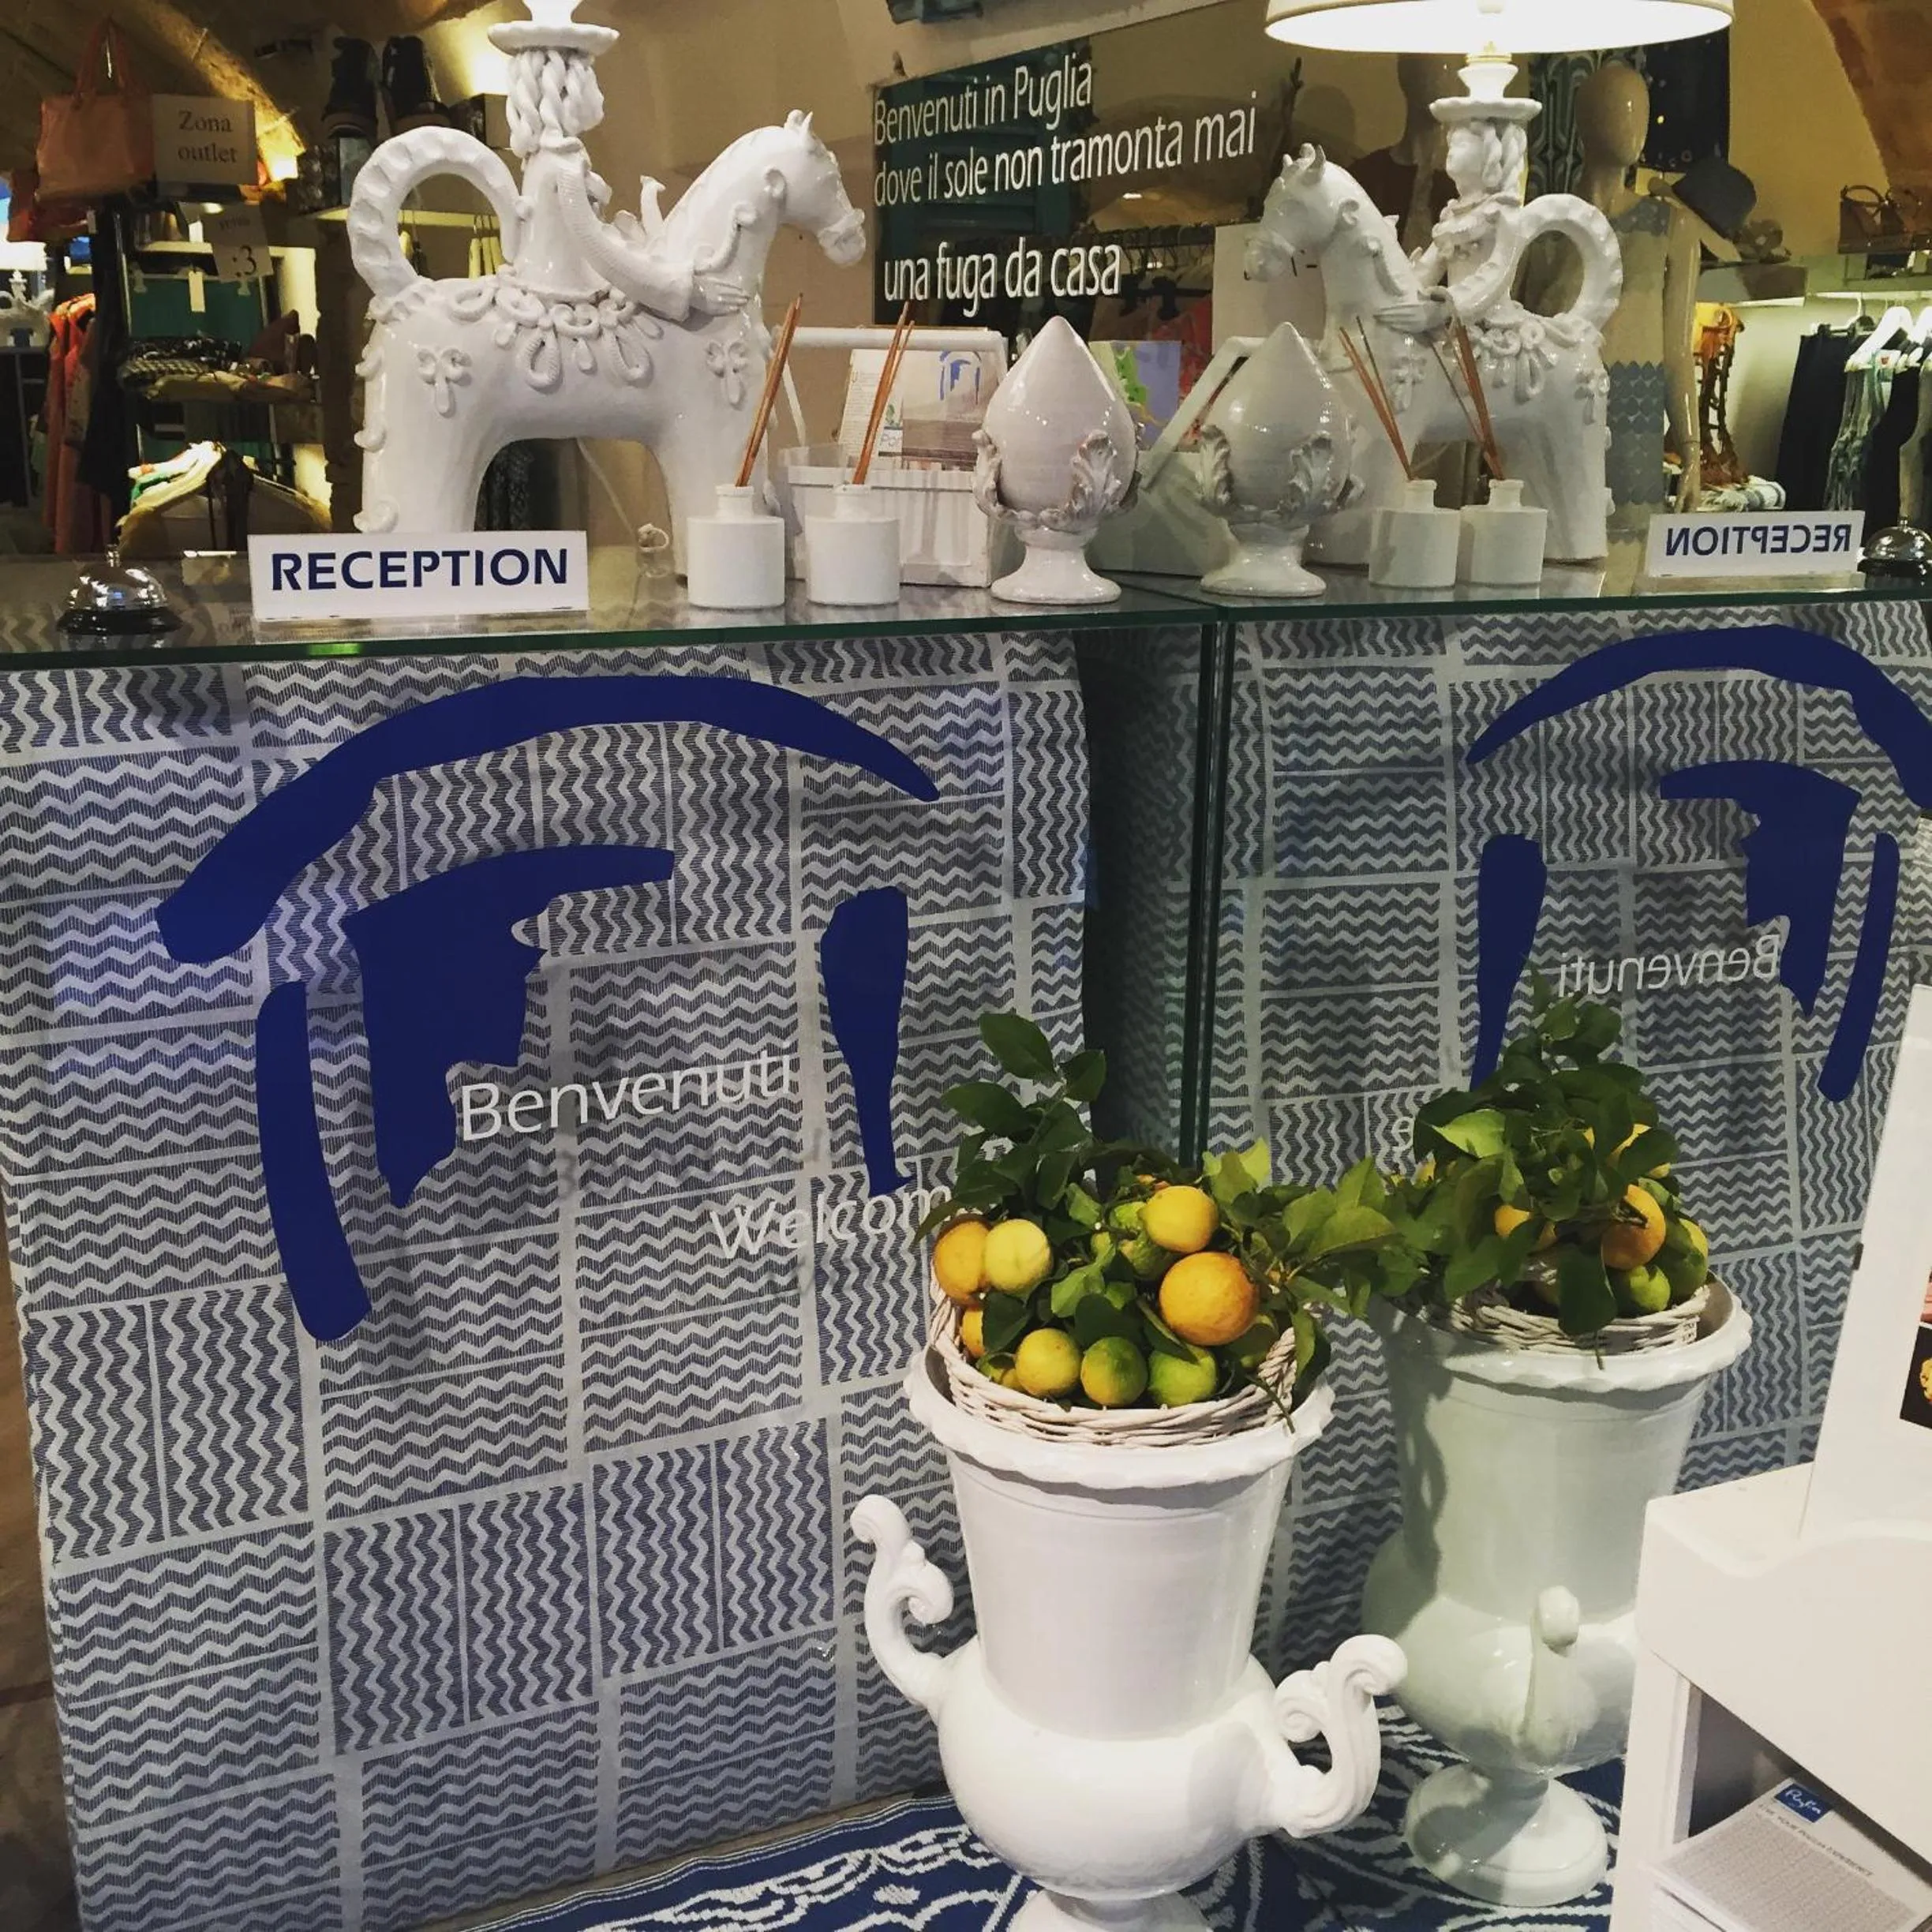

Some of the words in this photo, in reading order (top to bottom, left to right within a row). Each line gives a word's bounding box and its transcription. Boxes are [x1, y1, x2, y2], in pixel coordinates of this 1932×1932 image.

[178, 110, 234, 133] Zona
[874, 77, 978, 146] Benvenuti
[984, 75, 1005, 126] in
[1013, 52, 1092, 131] Puglia
[177, 143, 238, 163] outlet
[874, 161, 923, 207] dove
[928, 152, 938, 200] il
[943, 145, 987, 199] sole
[994, 145, 1043, 193] non
[1050, 116, 1183, 185] tramonta
[1193, 90, 1257, 163] mai
[884, 257, 930, 301] una
[936, 241, 998, 318] fuga
[1005, 236, 1043, 298] da
[1050, 244, 1121, 298] casa
[271, 548, 568, 590] RECEPTION
[460, 1042, 792, 1142] Benvenuti
[710, 1185, 953, 1260] Welcom
